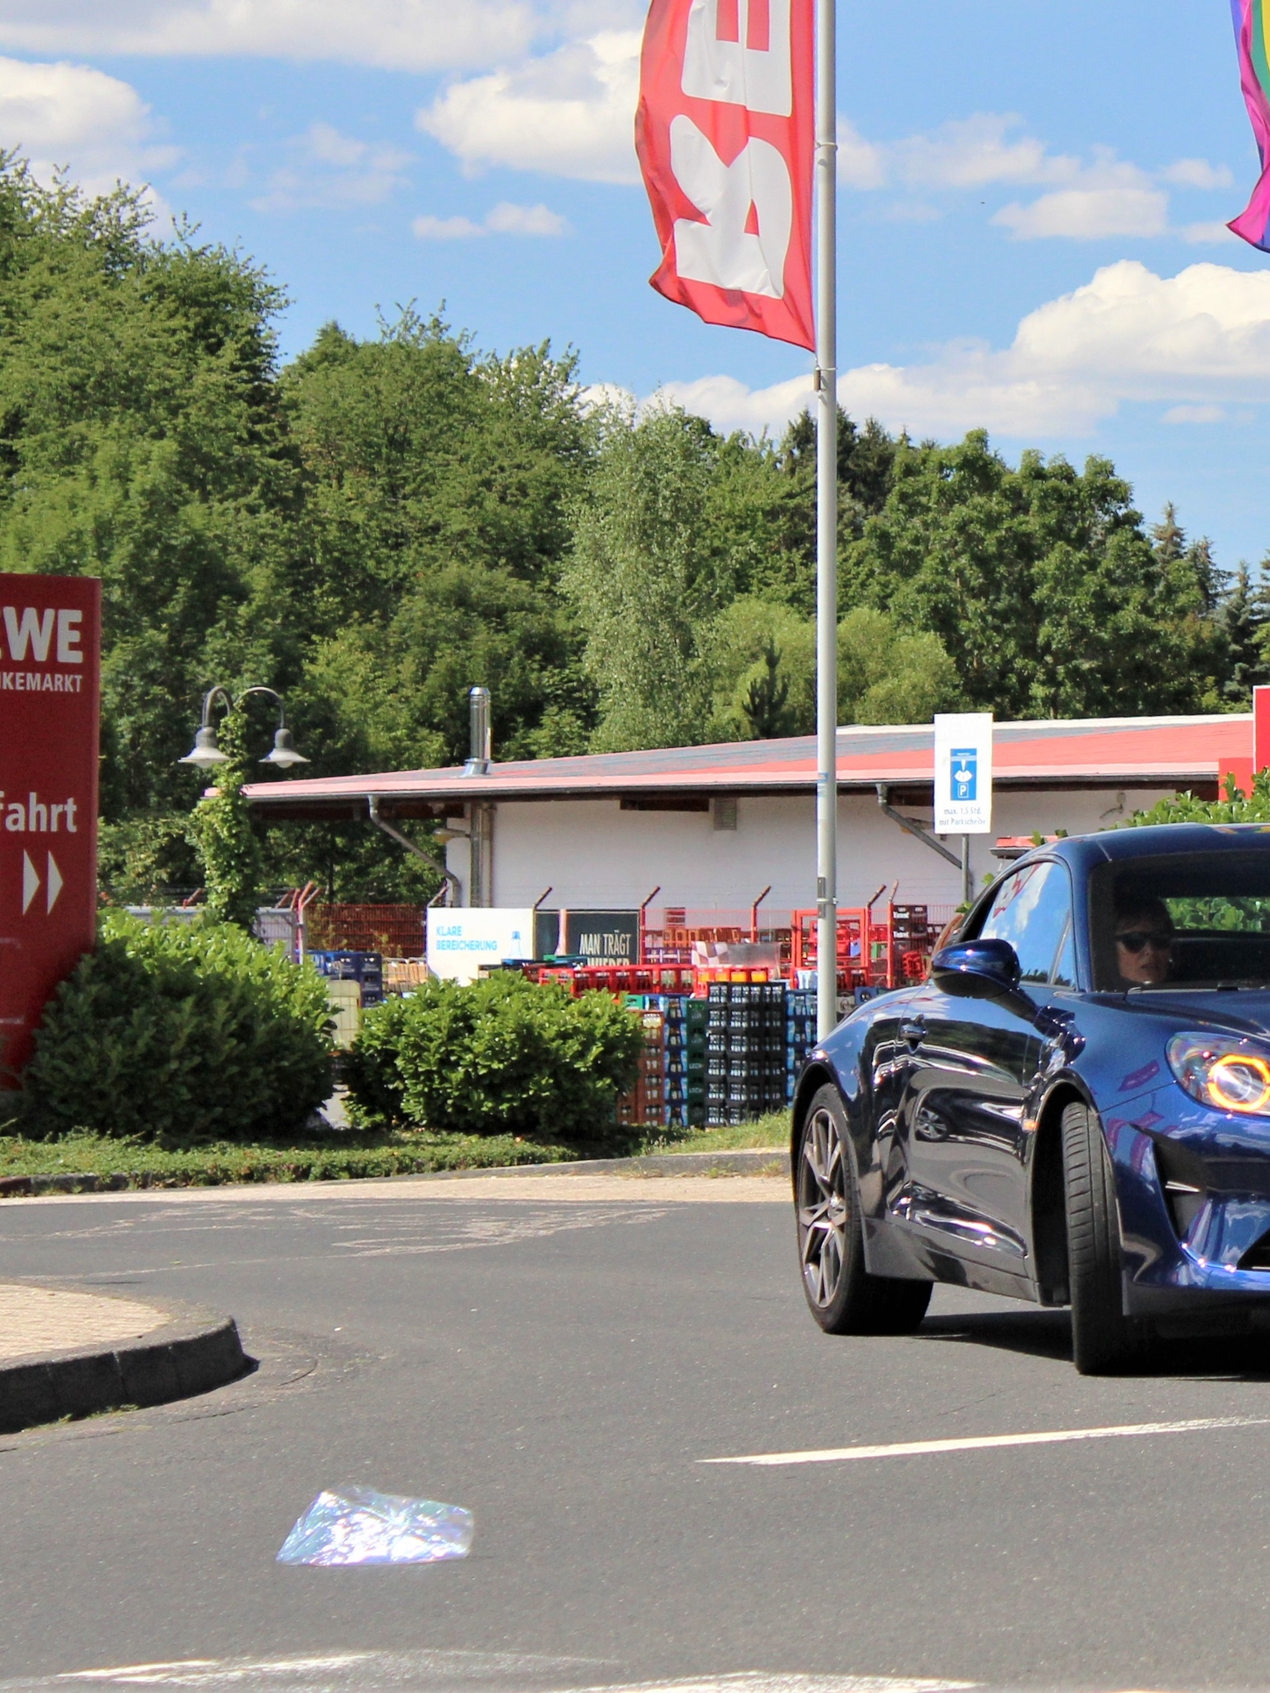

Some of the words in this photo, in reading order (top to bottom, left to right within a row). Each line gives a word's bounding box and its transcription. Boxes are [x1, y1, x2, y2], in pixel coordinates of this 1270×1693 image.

[0, 606, 83, 663] WE
[0, 672, 82, 692] KEMARKT
[436, 926, 462, 937] KLARE
[436, 940, 498, 951] BEREICHERUNG
[579, 934, 602, 956] MAN
[603, 929, 632, 956] TRÄGT
